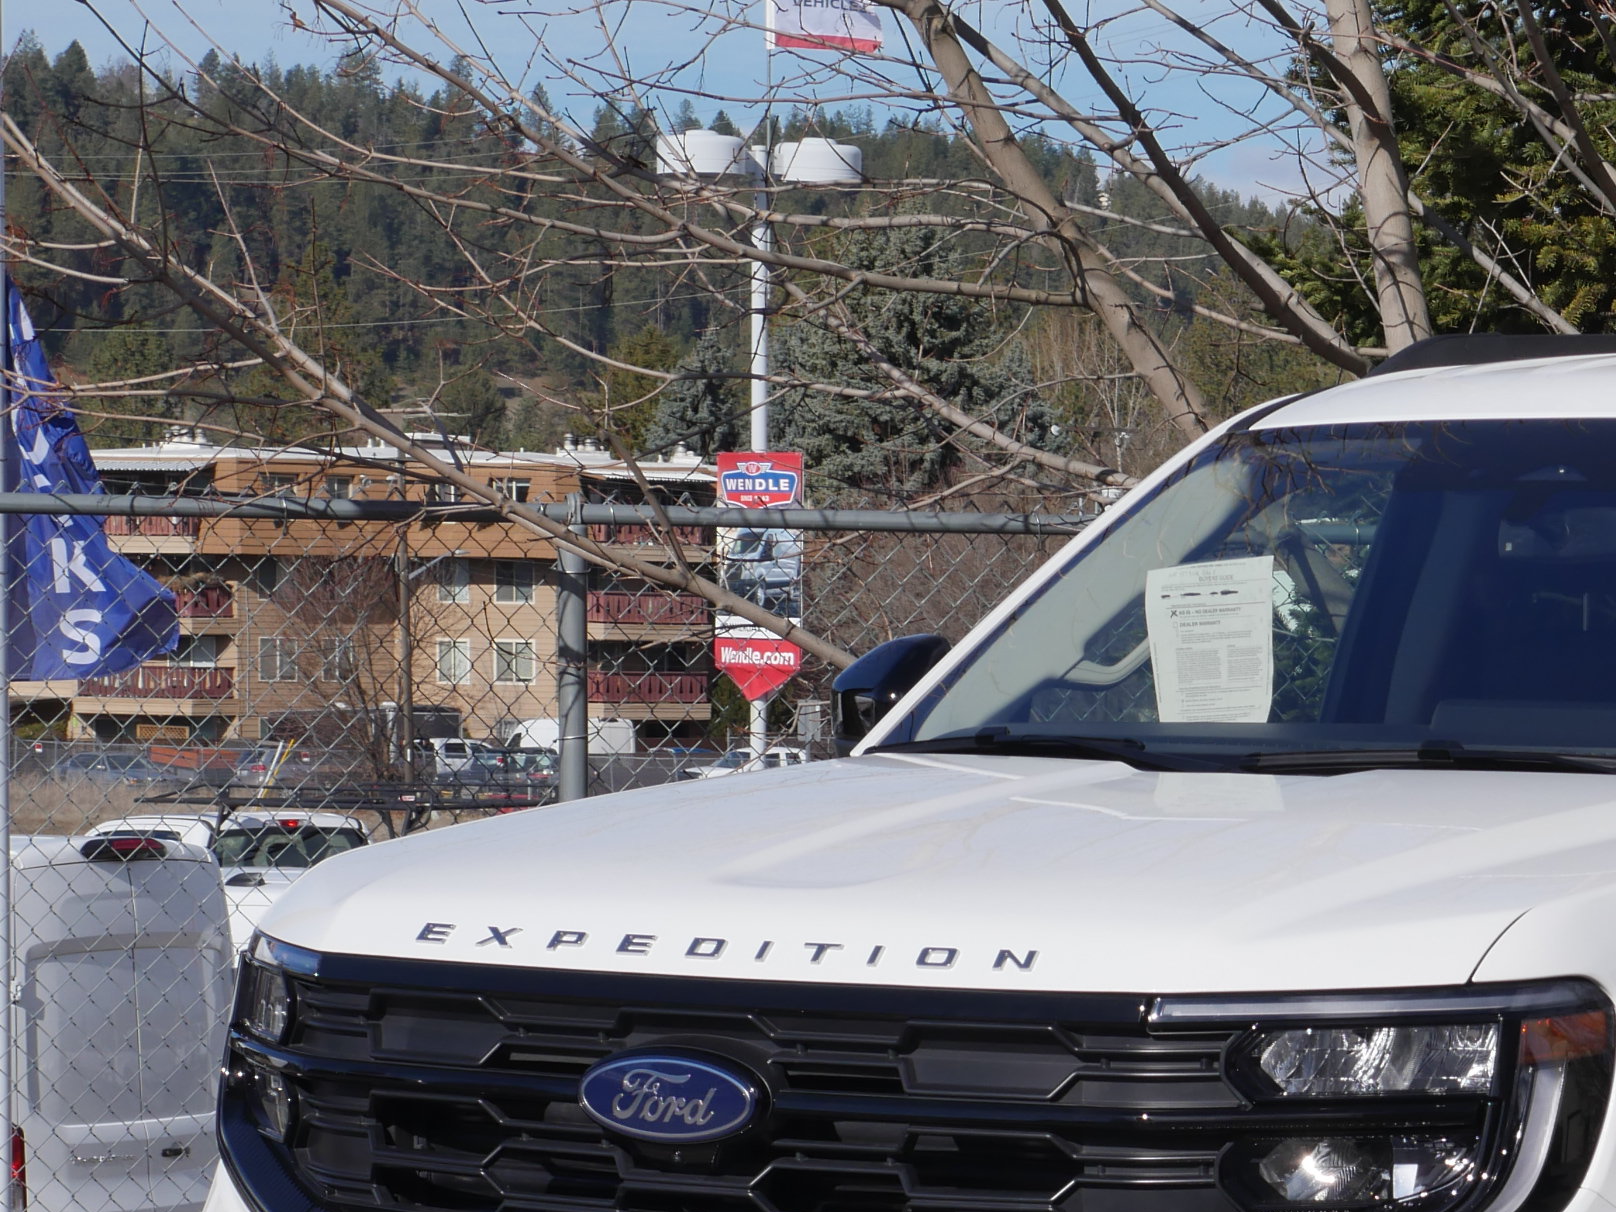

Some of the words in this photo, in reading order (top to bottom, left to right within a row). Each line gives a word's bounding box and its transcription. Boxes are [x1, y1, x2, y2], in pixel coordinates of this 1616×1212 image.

[726, 478, 790, 491] WENDLE
[720, 647, 795, 666] Wendle.com
[416, 922, 1040, 971] EXPEDITION
[612, 1068, 718, 1126] Ford
